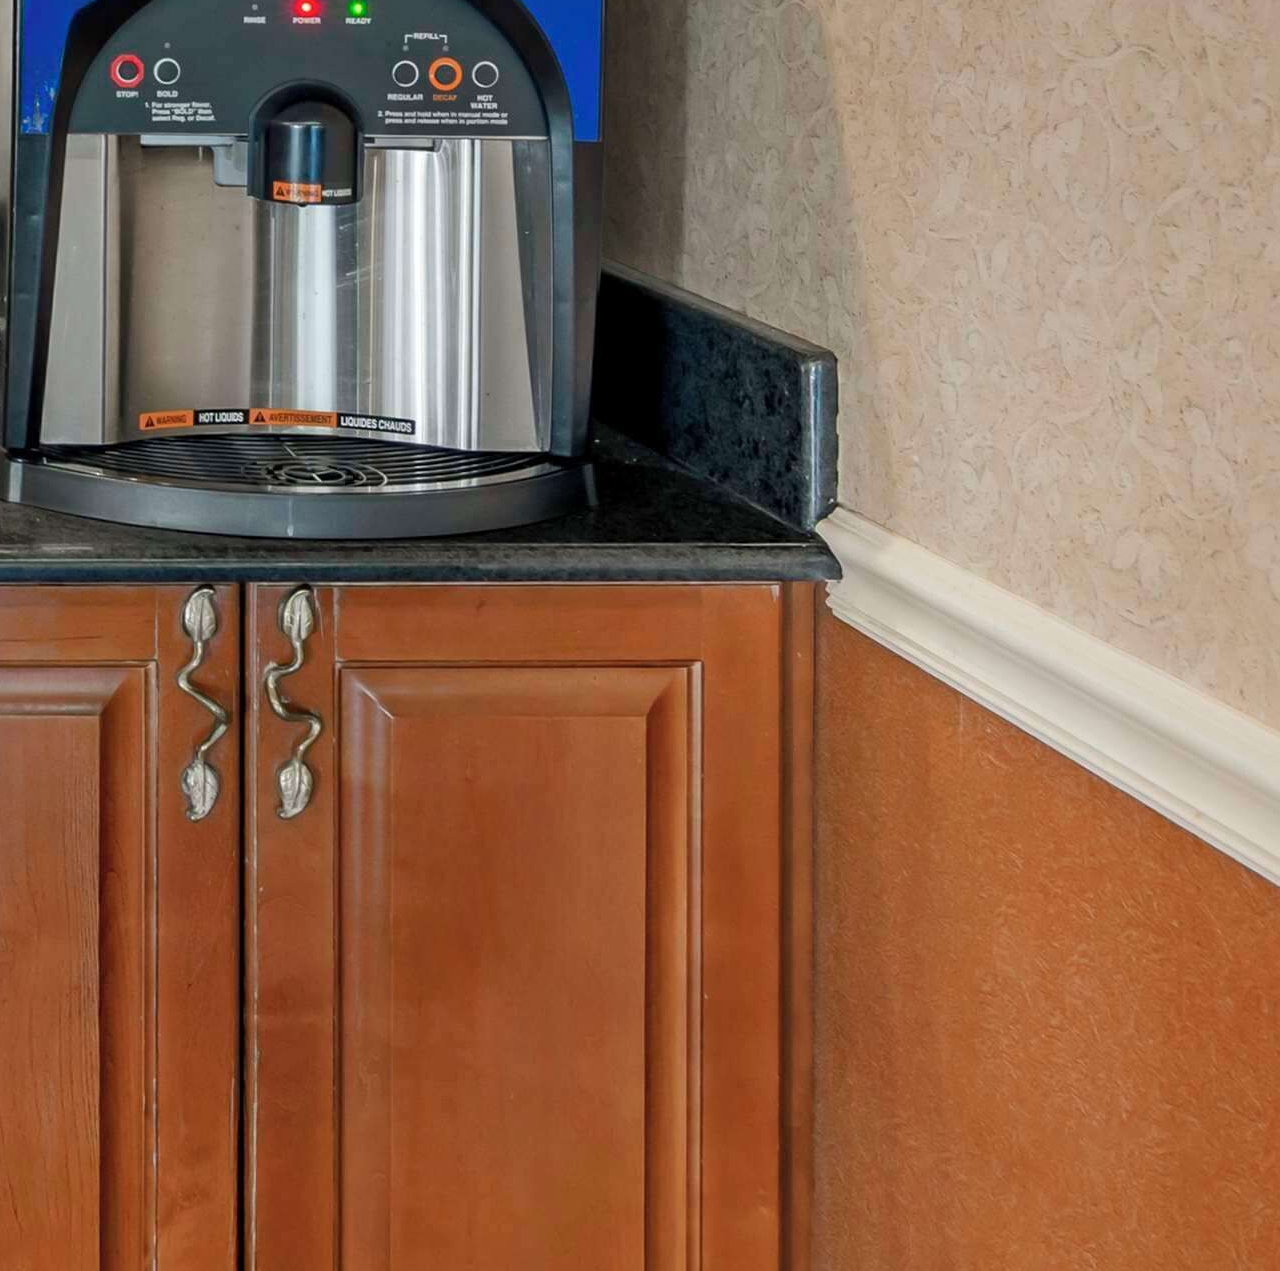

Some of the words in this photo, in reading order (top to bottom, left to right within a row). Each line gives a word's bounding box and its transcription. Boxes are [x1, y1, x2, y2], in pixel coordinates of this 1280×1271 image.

[292, 17, 321, 25] POWER
[345, 17, 372, 25] READY
[413, 32, 439, 40] REFILL
[156, 90, 178, 98] BOLD
[387, 93, 423, 101] REGULAR
[385, 110, 402, 118] Press
[156, 414, 187, 424] WARNING
[199, 412, 214, 423] HOT
[215, 411, 244, 423] LIQUIDS
[269, 412, 332, 424] AVERTISSEMENT
[340, 415, 377, 429] LIQUIDES
[378, 419, 413, 433] CHAUDS
